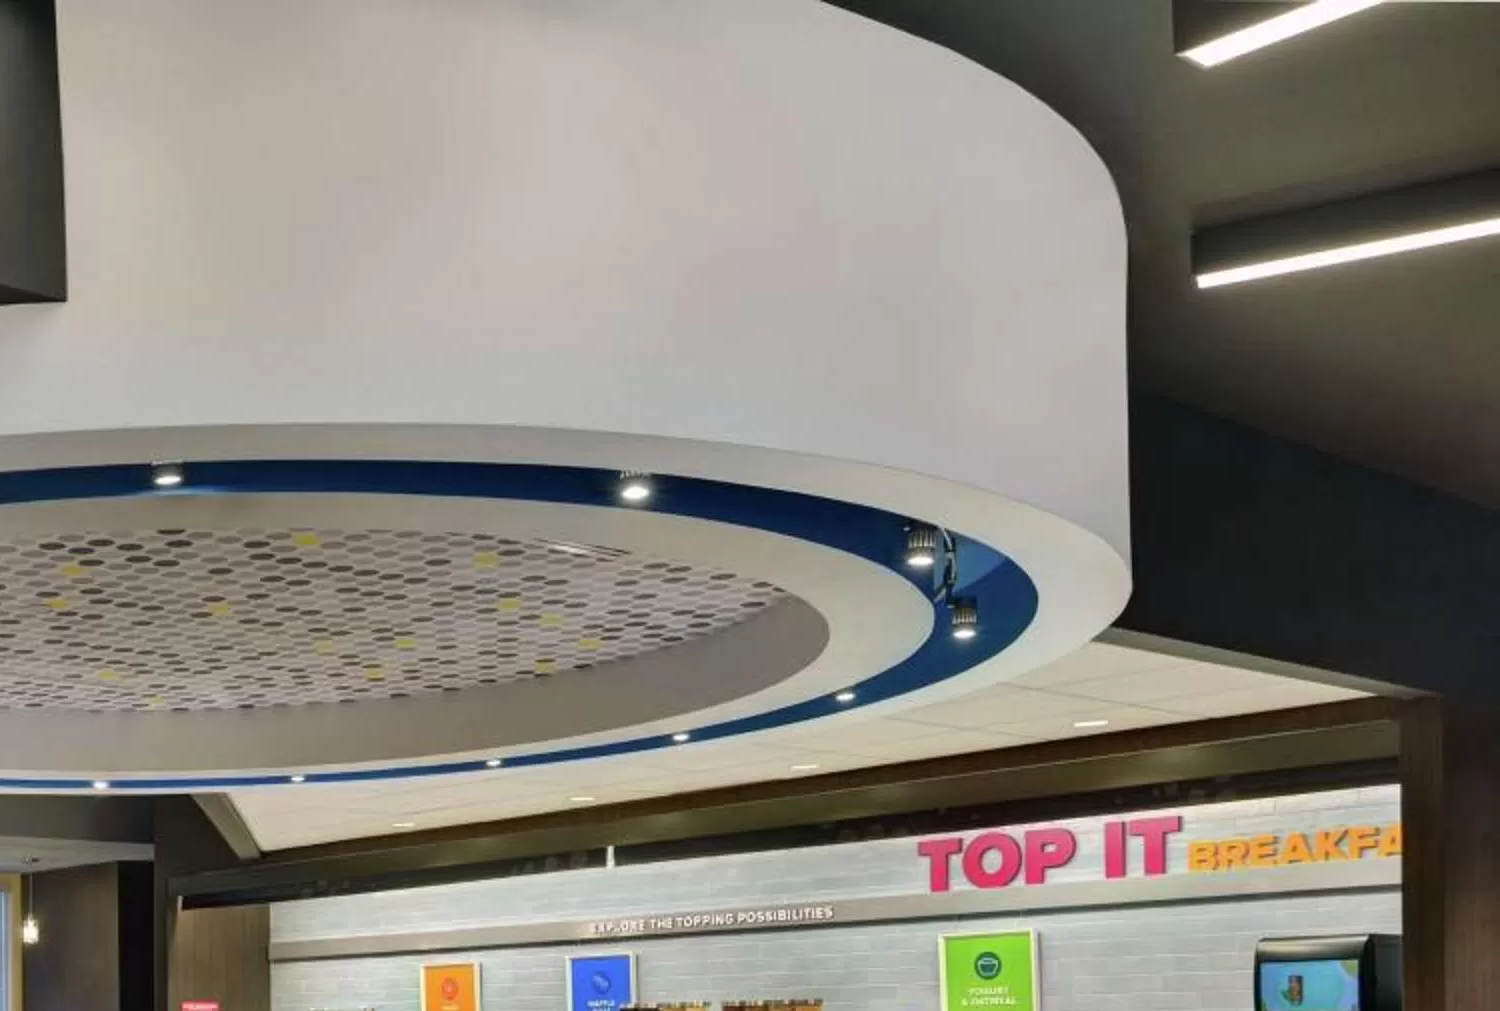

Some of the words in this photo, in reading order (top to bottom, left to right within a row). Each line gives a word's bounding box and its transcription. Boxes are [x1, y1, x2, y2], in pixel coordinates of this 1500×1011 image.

[918, 827, 1077, 893] TOP
[1104, 815, 1183, 880] IT
[650, 916, 673, 929] THE
[676, 911, 734, 928] TOPPING
[737, 904, 835, 924] POSSIBILITIES
